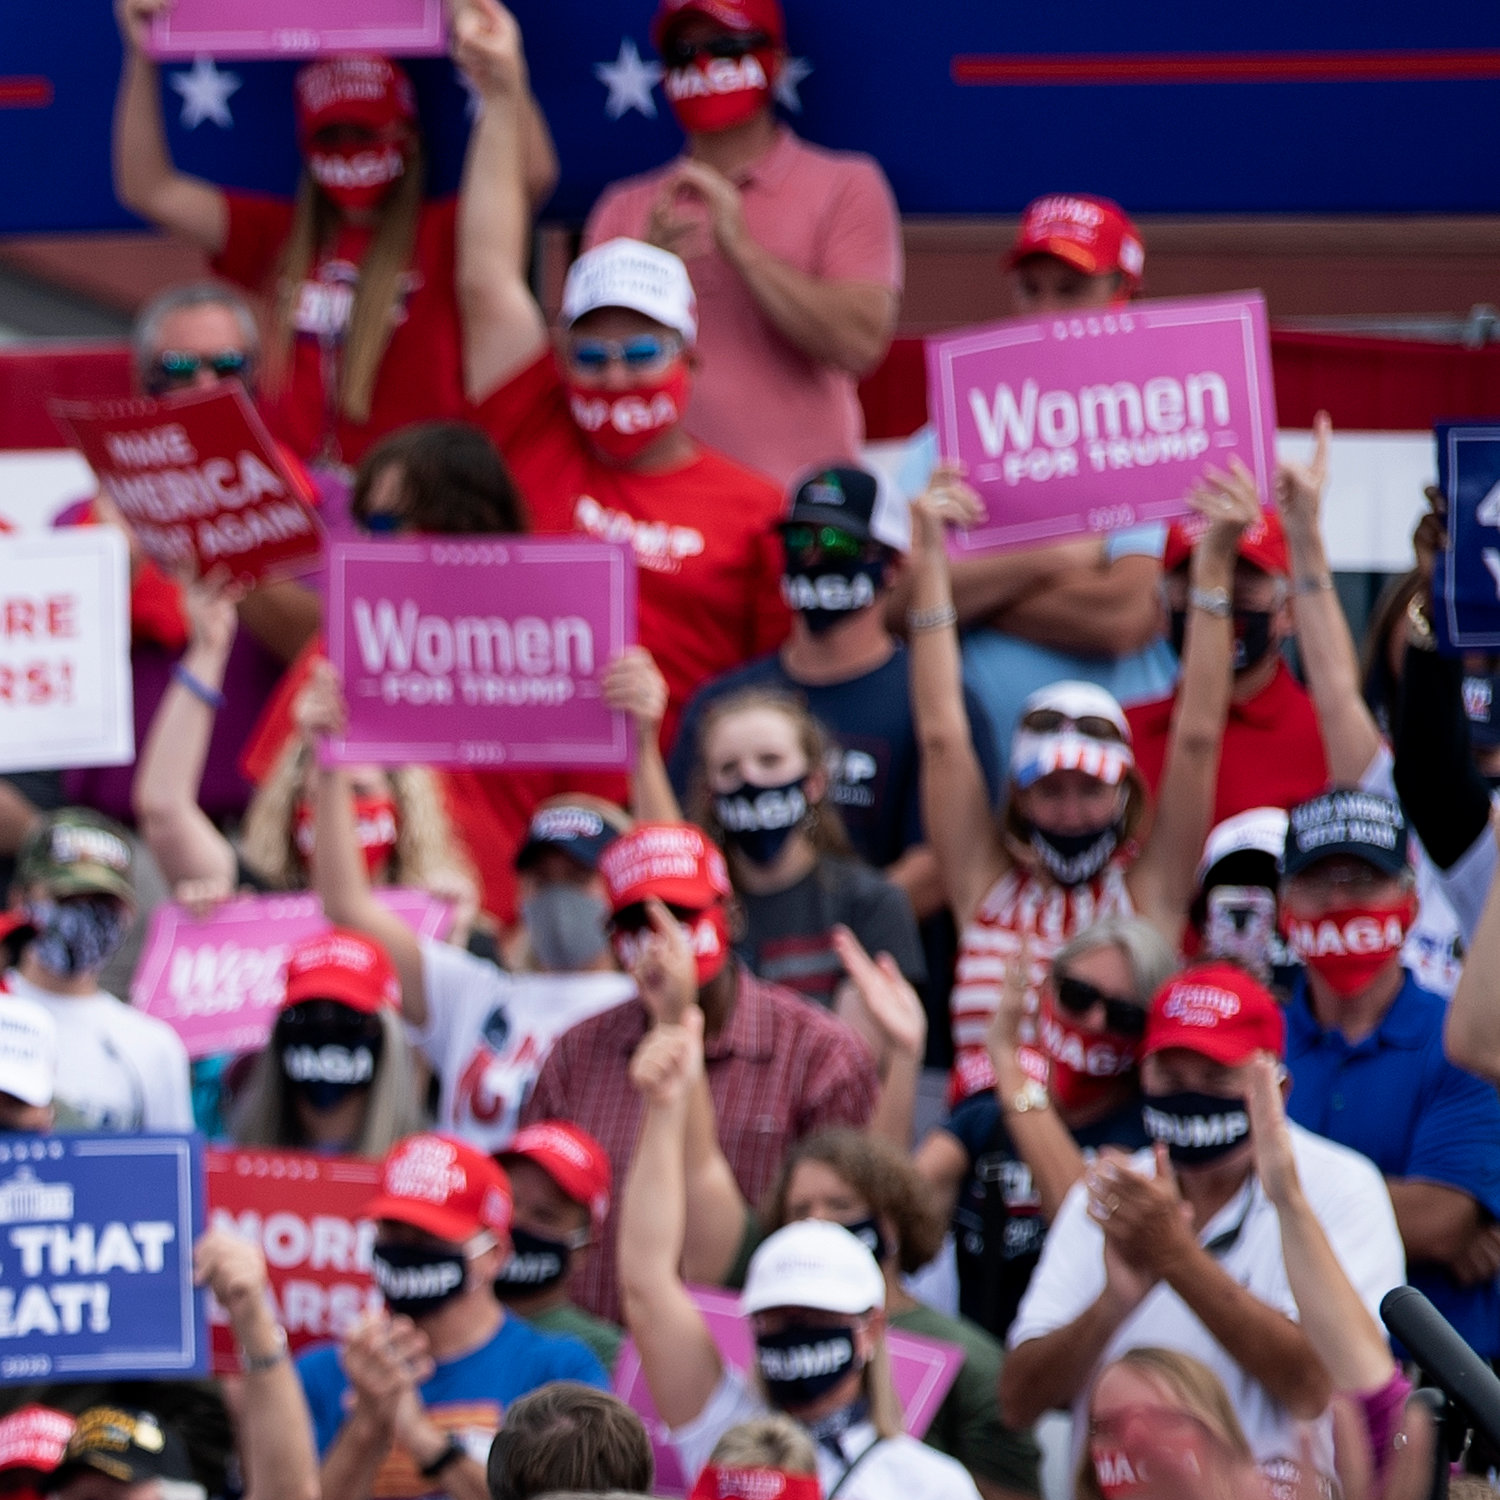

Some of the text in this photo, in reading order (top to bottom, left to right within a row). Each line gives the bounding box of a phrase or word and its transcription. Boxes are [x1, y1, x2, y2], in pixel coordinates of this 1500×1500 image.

[664, 54, 767, 98] MAGA
[968, 370, 1232, 460] Women
[1002, 426, 1210, 486] FOR TRUMP
[200, 506, 312, 560] AGAIN
[780, 572, 876, 612] MAGA
[352, 598, 596, 678] Women
[382, 670, 574, 706] FOR TRUMP
[1290, 916, 1404, 958] MAGA
[284, 1043, 374, 1084] MAGA
[1143, 1104, 1250, 1148] TRUMP
[9, 1220, 178, 1278] THAT
